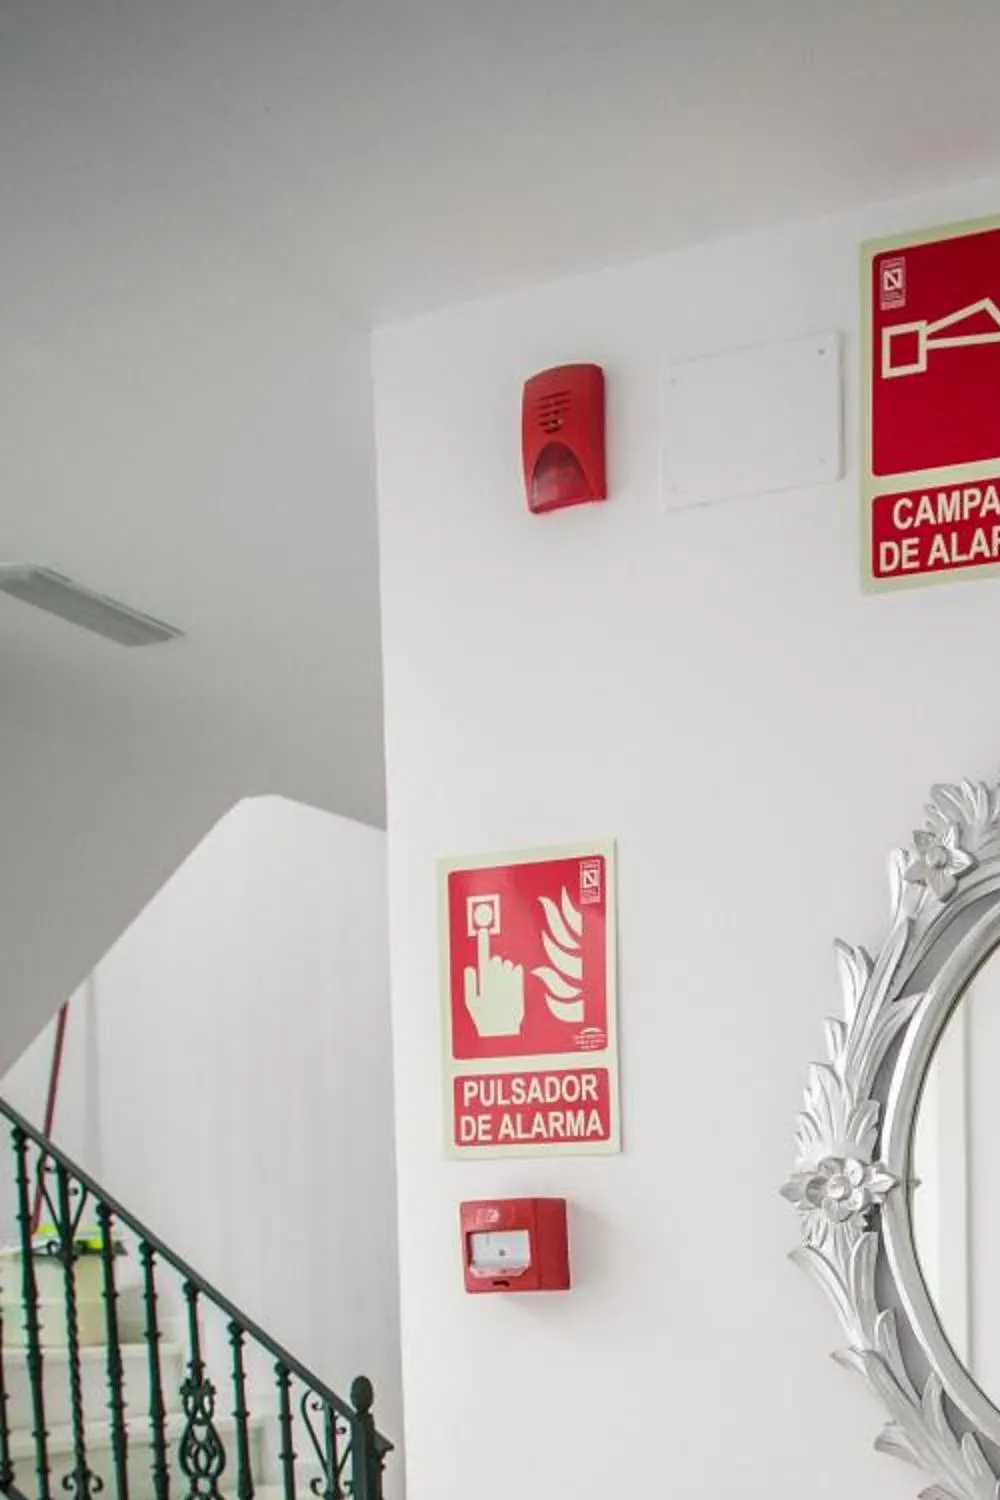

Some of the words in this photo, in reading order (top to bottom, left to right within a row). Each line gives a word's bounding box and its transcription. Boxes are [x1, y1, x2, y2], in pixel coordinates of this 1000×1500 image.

[879, 537, 921, 573] DE
[463, 1073, 599, 1107] PULSADOR
[460, 1114, 492, 1141] DE
[498, 1109, 604, 1139] ALARMA
